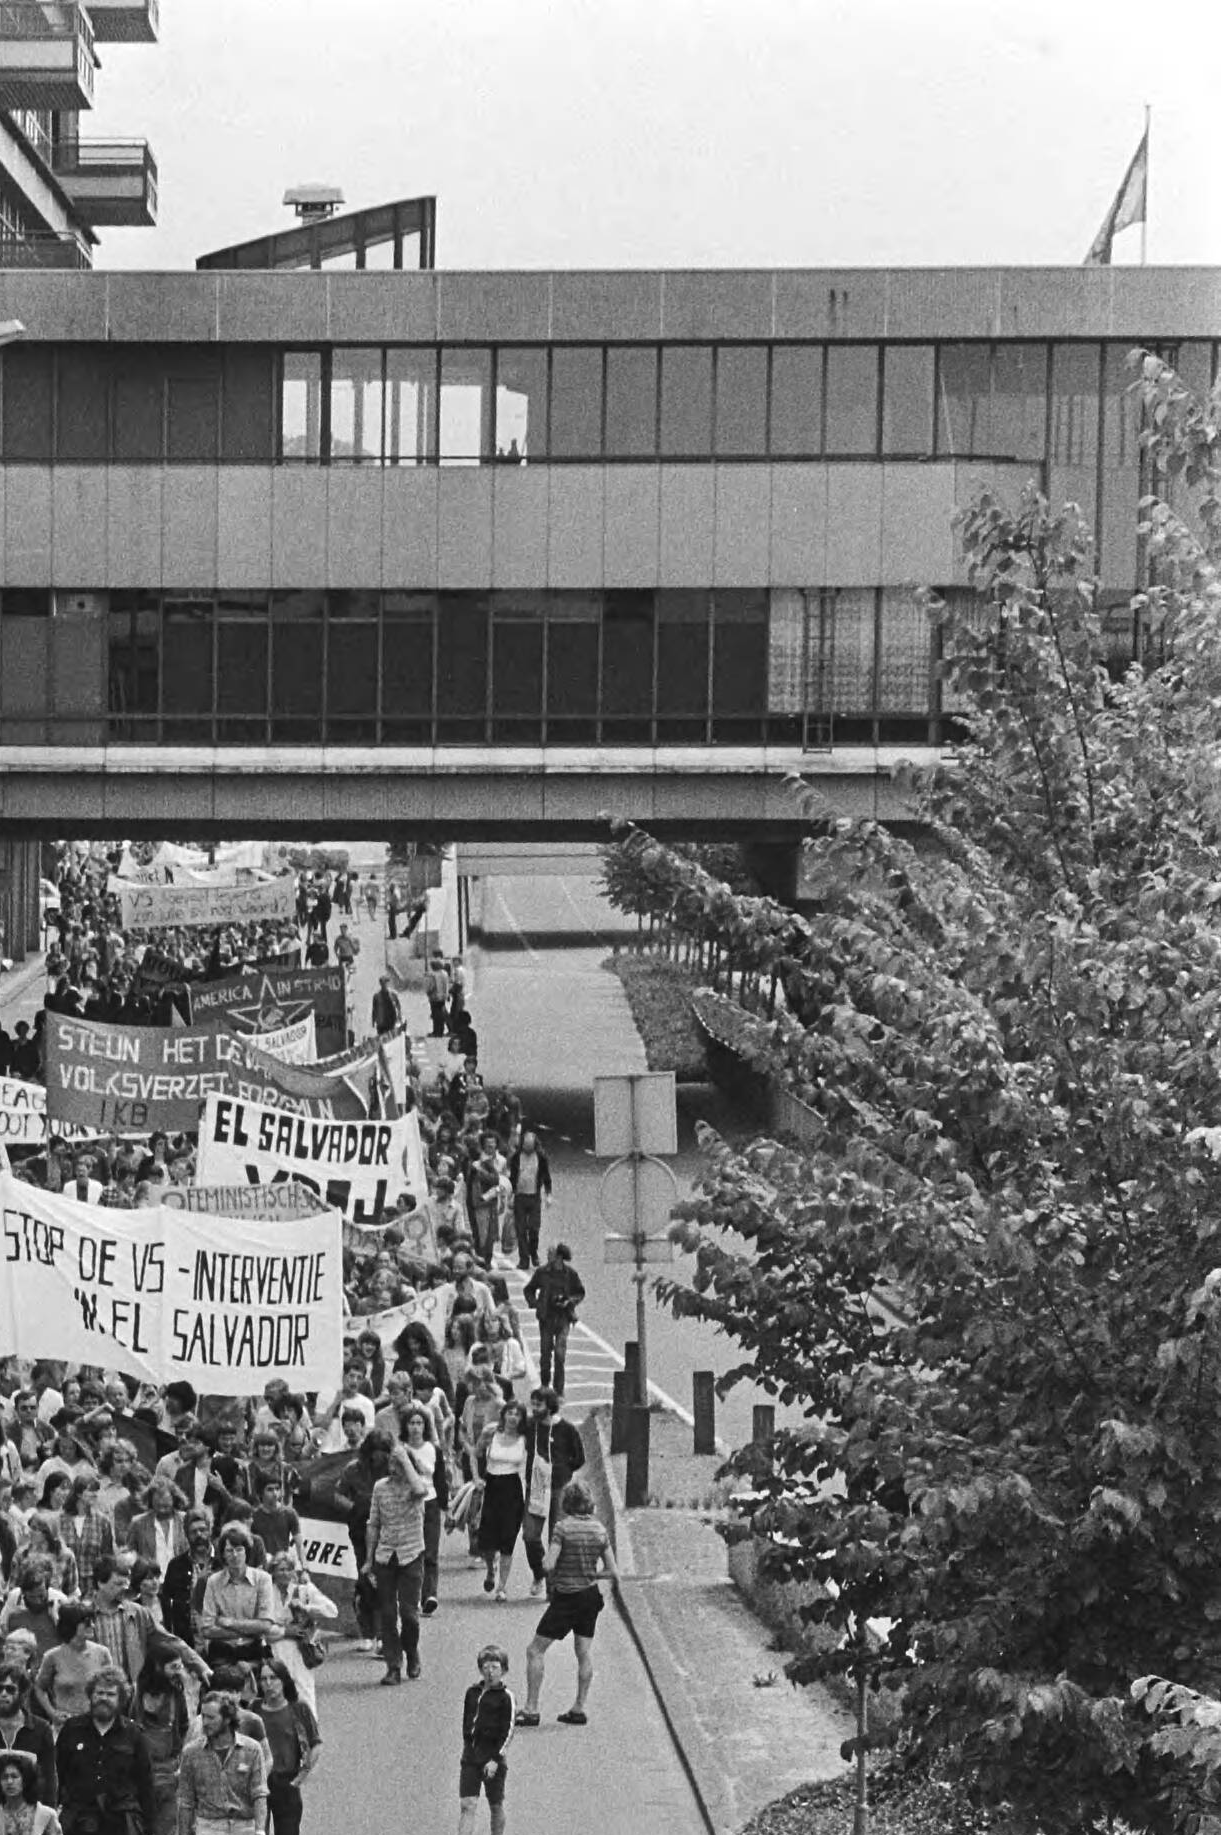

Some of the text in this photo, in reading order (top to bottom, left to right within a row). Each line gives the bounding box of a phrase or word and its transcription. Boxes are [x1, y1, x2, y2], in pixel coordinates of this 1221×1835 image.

[193, 984, 252, 1011] AMERICA
[276, 980, 291, 998] IN
[58, 1025, 140, 1064] STEUN
[163, 1036, 210, 1064] HET
[214, 1100, 248, 1146] EL
[258, 1112, 392, 1165] SALVADOR
[3, 1209, 64, 1266] STOP
[80, 1237, 117, 1286] DE
[132, 1242, 165, 1293] VS
[172, 1309, 309, 1366] SALVADOR
